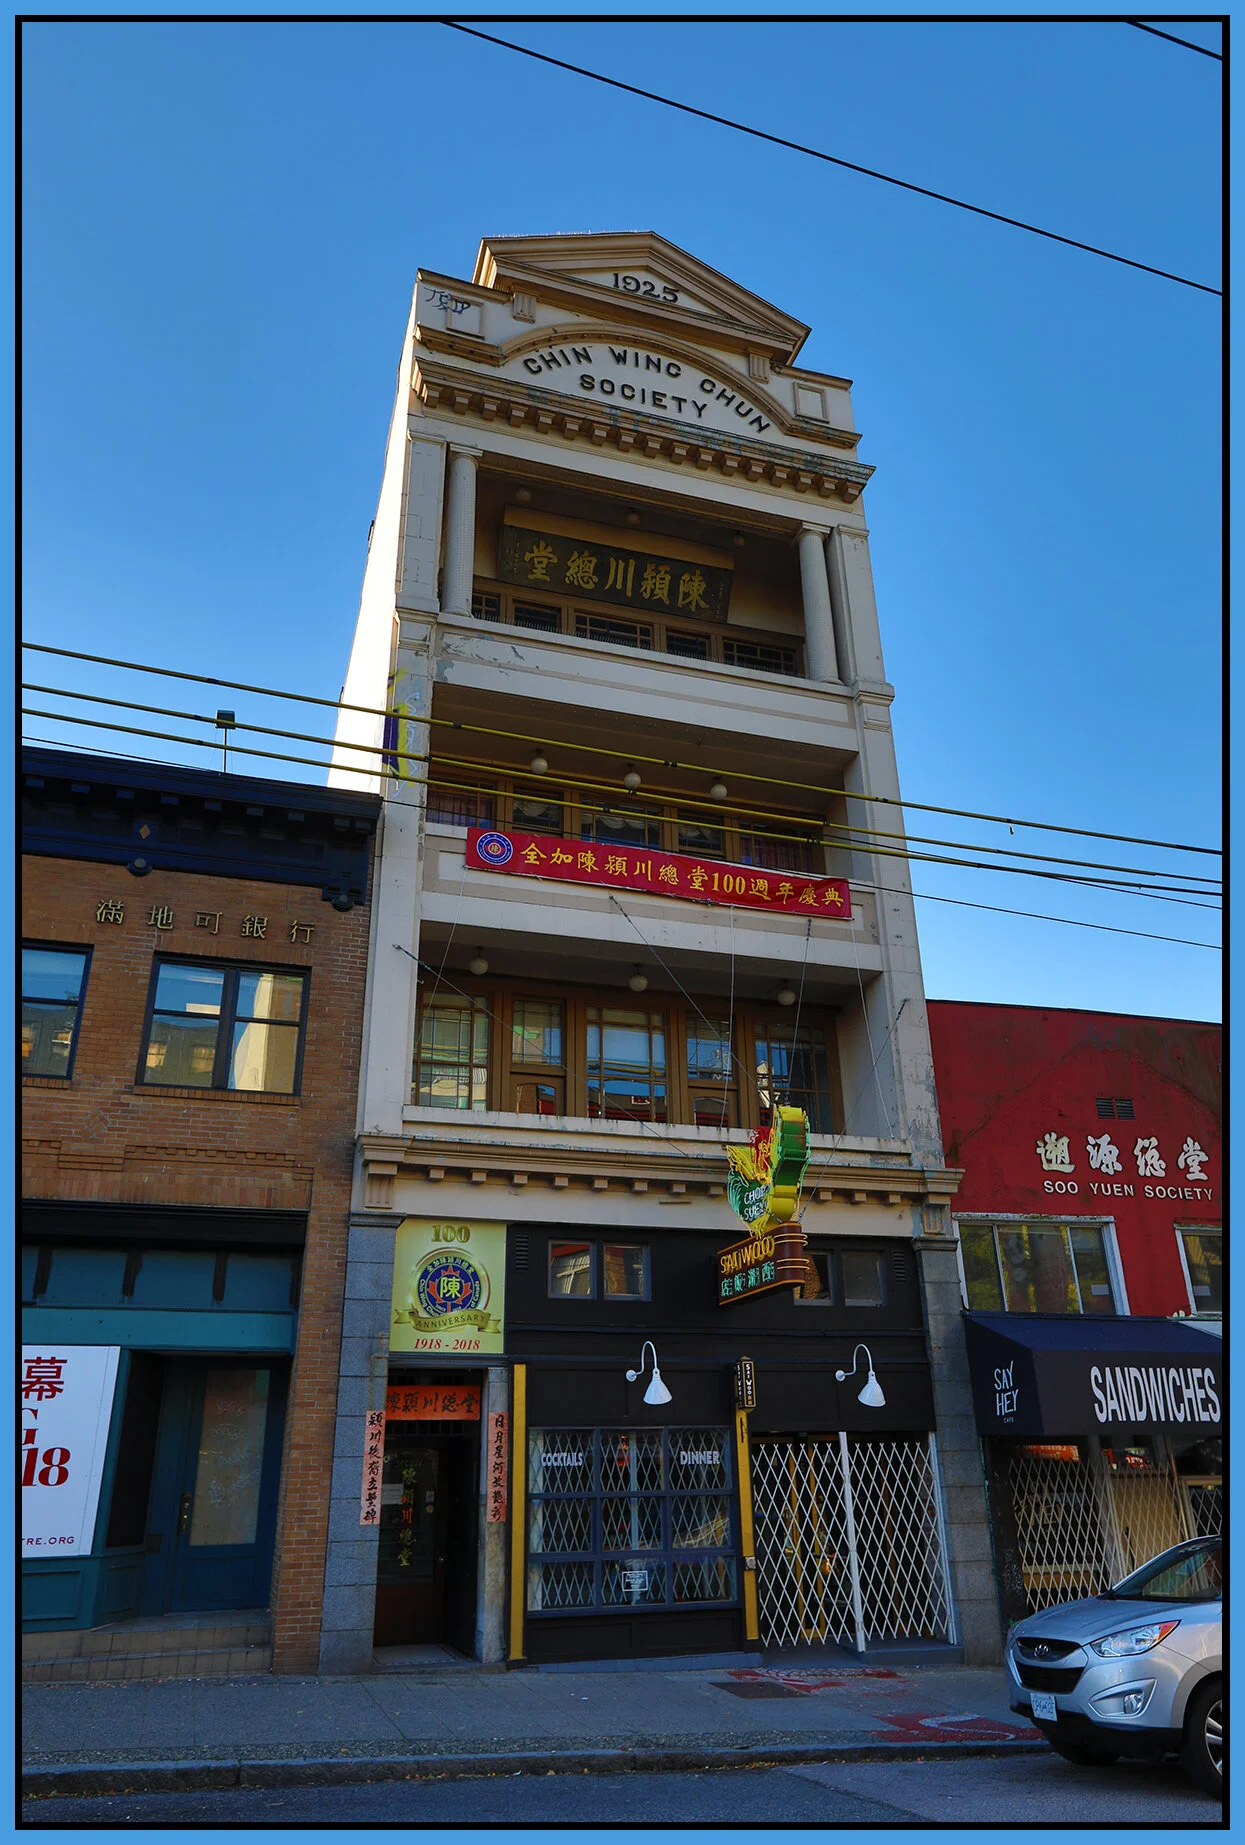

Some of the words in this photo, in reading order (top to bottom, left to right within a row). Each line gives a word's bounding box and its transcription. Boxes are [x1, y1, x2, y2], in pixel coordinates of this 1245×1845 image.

[612, 272, 680, 304] 1925
[523, 346, 593, 375] CHIN
[608, 346, 682, 378] WING
[699, 378, 771, 434] CHUN
[579, 373, 708, 419] SOCIETY
[95, 899, 316, 944] 滿地可銀行
[743, 1183, 770, 1205] CHOP
[1043, 1180, 1079, 1195] SOO
[1089, 1182, 1135, 1198] YUEN
[1144, 1184, 1213, 1201] SOCIETY
[431, 1225, 471, 1244] 100
[440, 1276, 461, 1299] 陳
[415, 1314, 487, 1329] ANNIVERSARY
[414, 1338, 442, 1350] 1918
[452, 1338, 481, 1350] 2018
[993, 1360, 1014, 1391] SAY
[996, 1389, 1019, 1416] HEY
[1090, 1366, 1222, 1424] SANDWICHES
[541, 1452, 583, 1467] COCKTAILS
[679, 1451, 721, 1466] DINNER
